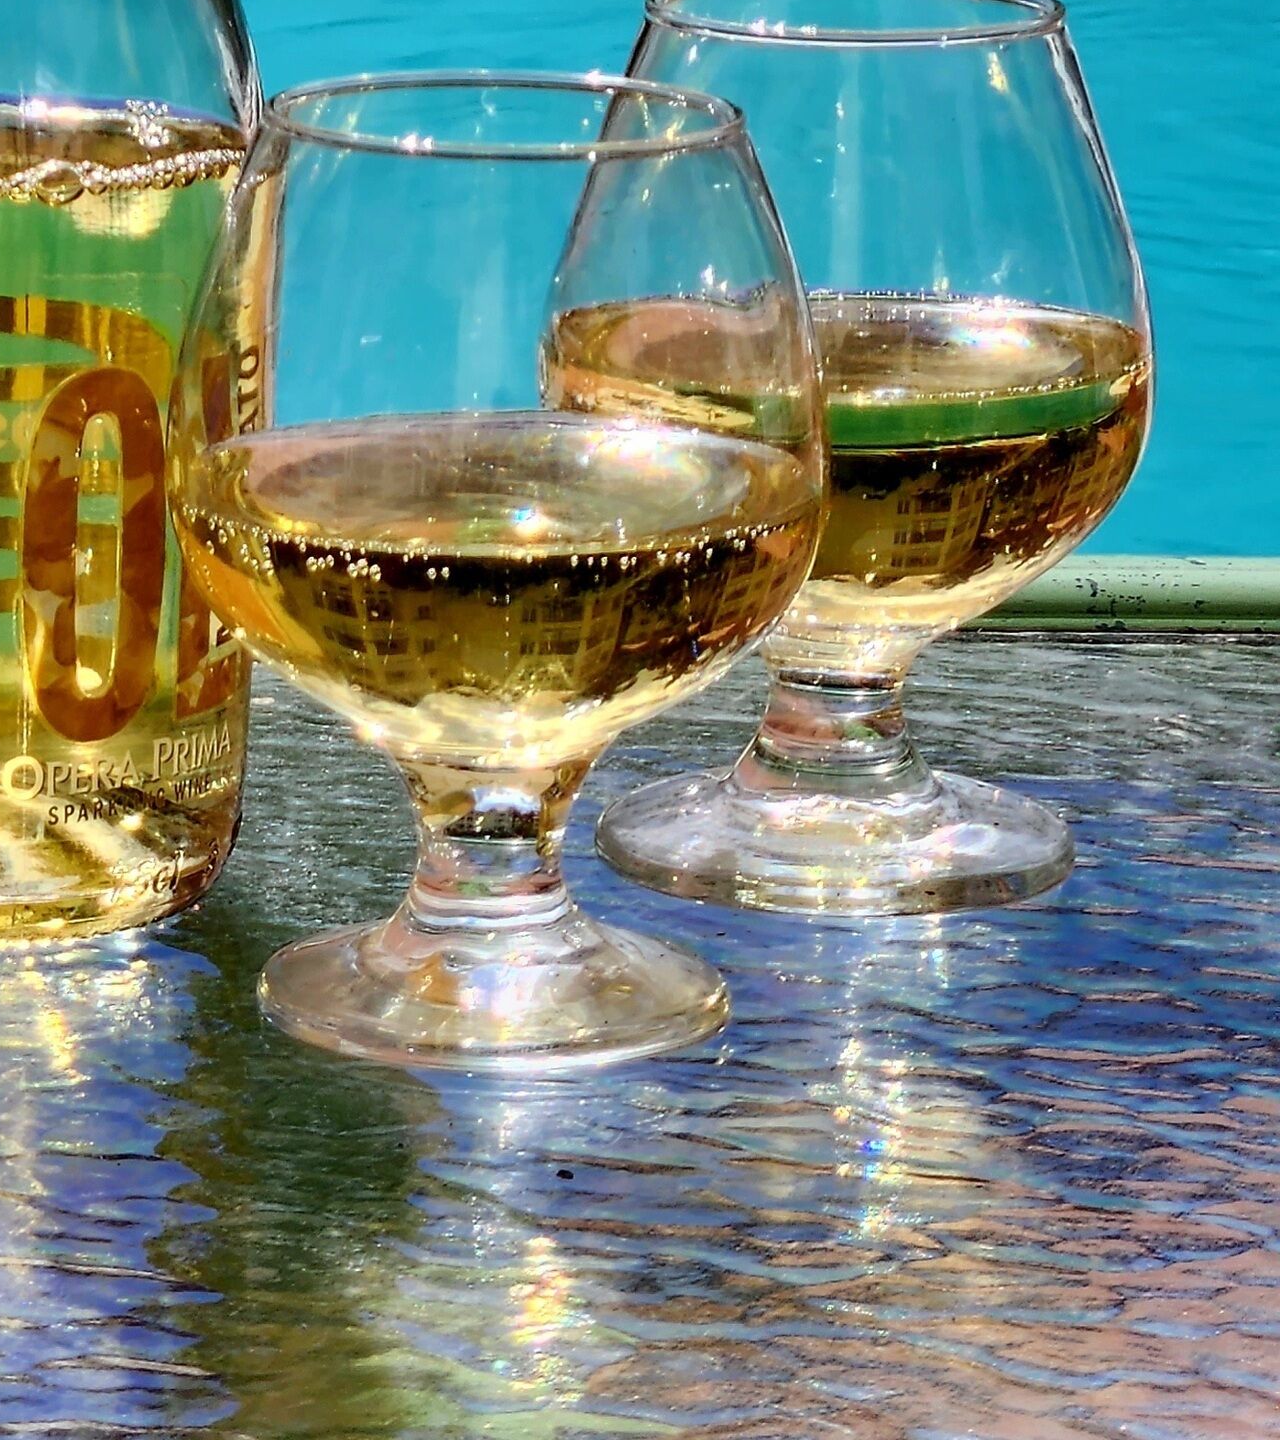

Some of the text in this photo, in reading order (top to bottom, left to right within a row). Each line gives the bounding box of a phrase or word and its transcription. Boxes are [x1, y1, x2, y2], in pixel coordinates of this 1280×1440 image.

[0, 748, 141, 801] OPERA
[151, 719, 232, 782] PRIMA
[47, 786, 167, 826] SPARKNG
